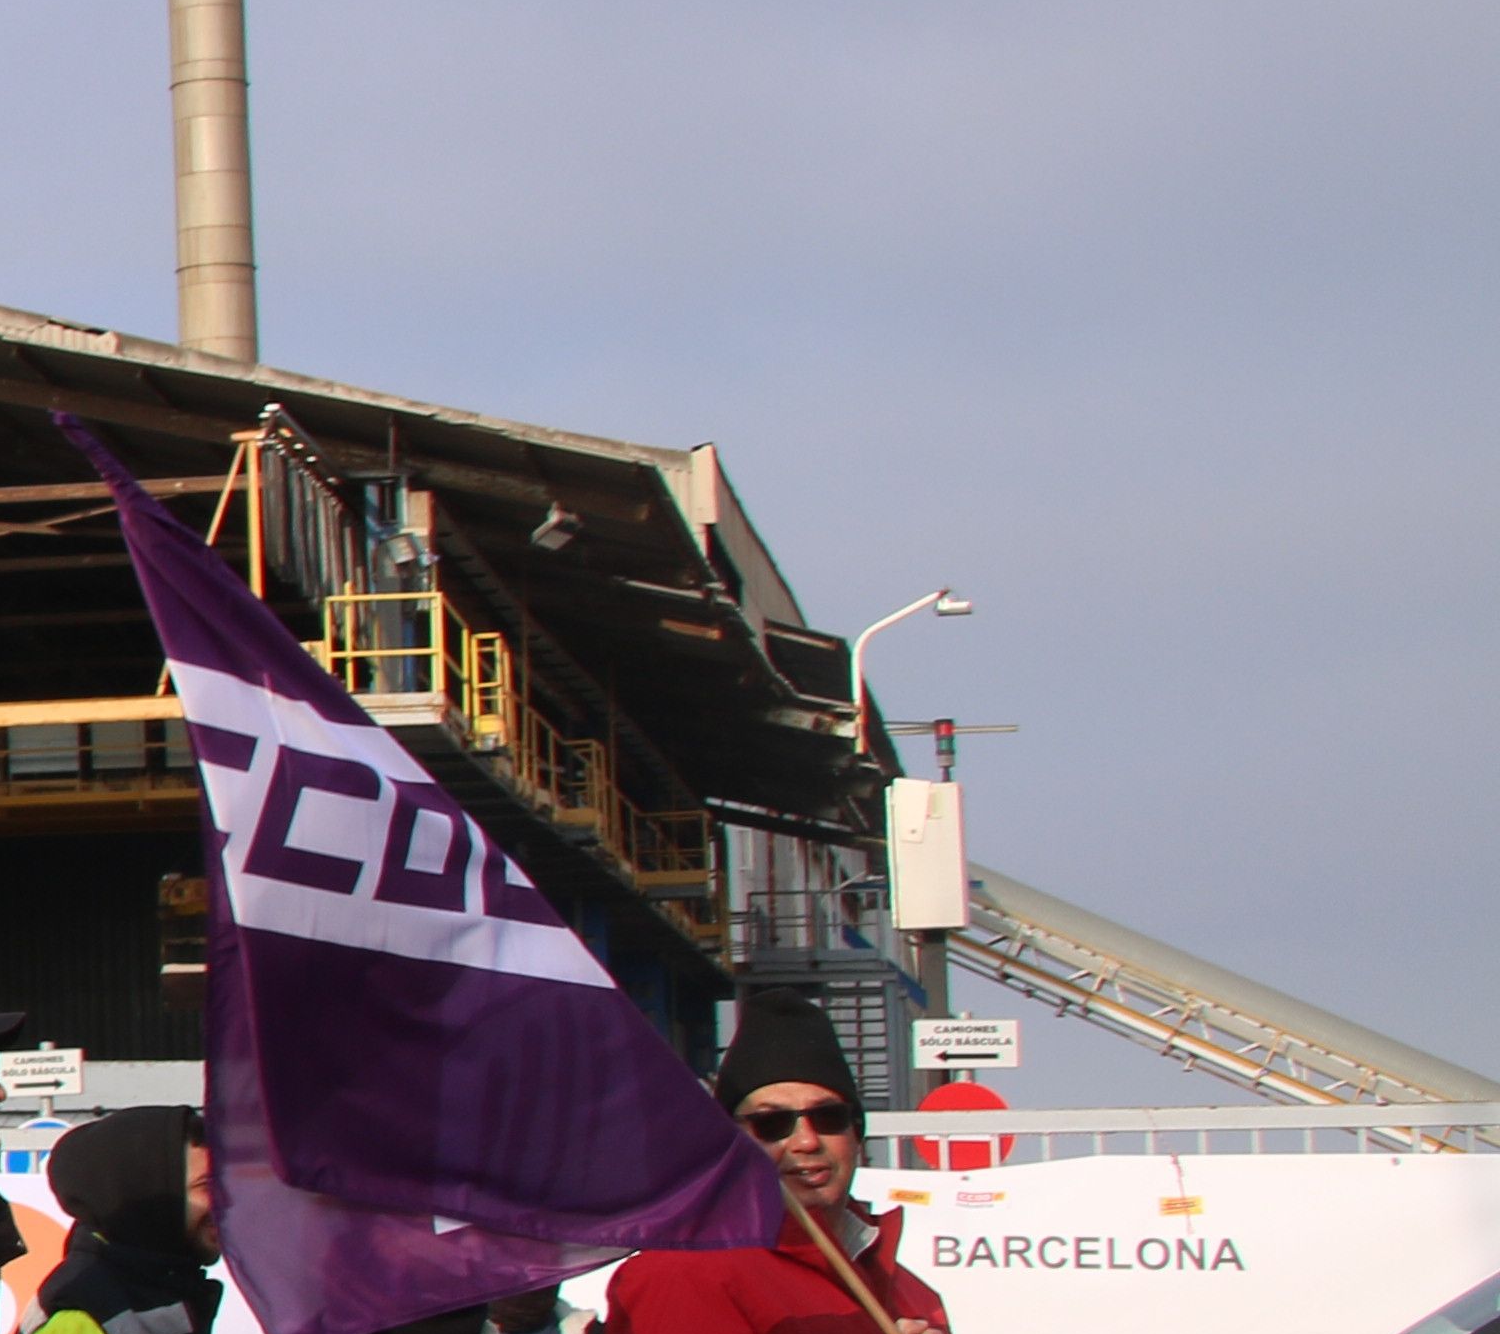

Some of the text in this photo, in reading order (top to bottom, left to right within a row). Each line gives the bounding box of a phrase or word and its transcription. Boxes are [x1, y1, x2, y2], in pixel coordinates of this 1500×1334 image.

[933, 1026, 998, 1034] CAMIONES
[919, 1037, 1012, 1046] SÓLO BÁSCULA
[13, 1056, 65, 1065] CAMIONES
[932, 1235, 1245, 1271] BARCELONA
